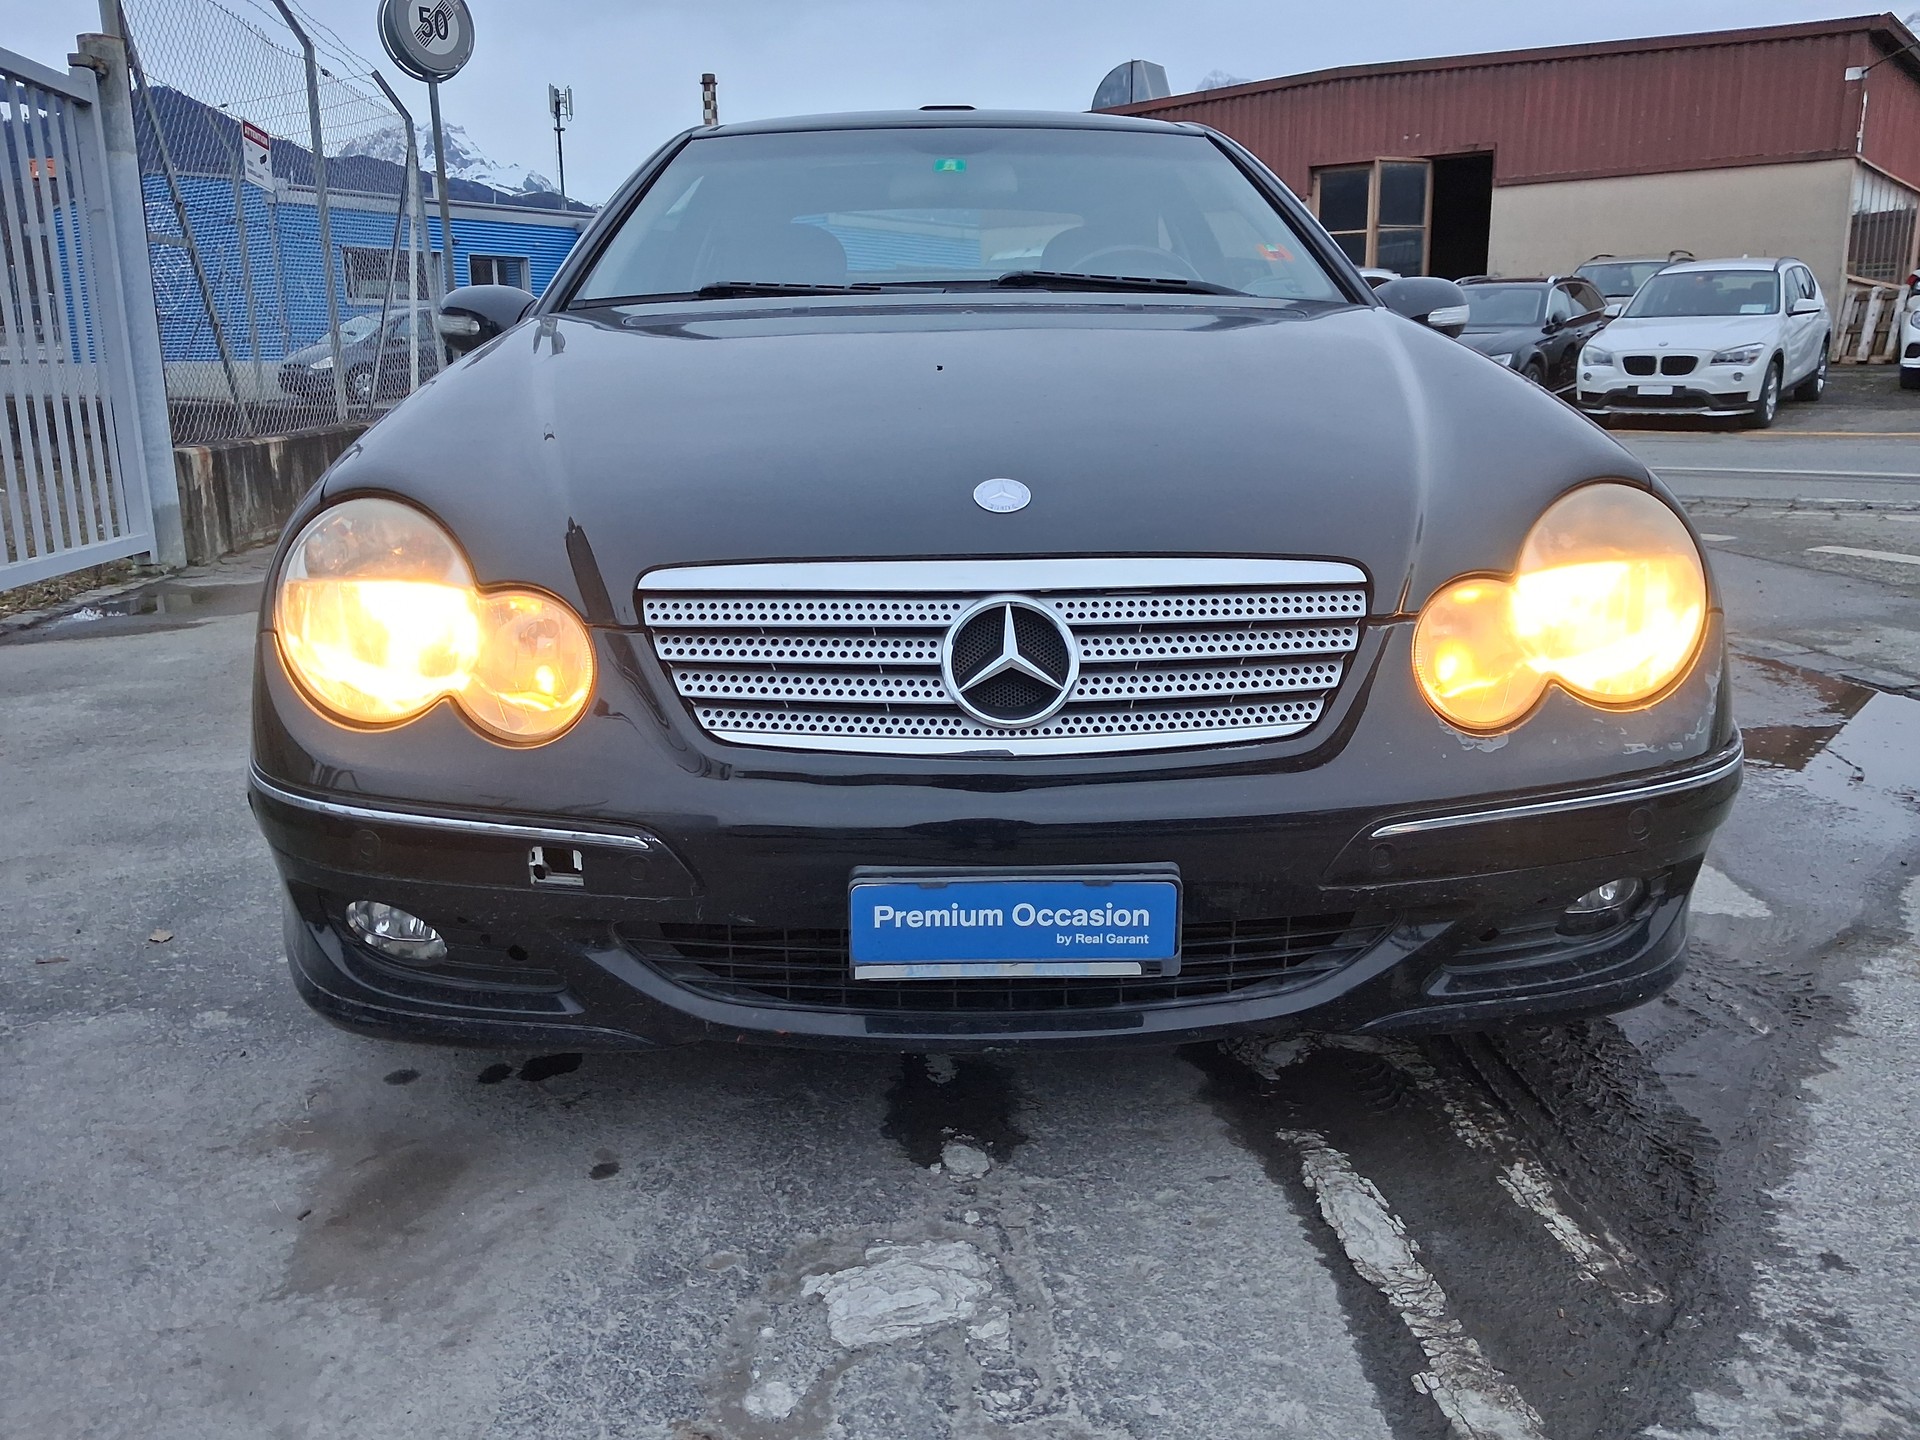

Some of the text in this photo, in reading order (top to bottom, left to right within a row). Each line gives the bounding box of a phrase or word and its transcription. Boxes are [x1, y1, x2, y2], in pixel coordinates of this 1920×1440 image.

[418, 6, 449, 40] 50
[874, 902, 1149, 928] Premium Occasion
[1056, 933, 1149, 946] by Real Garant
